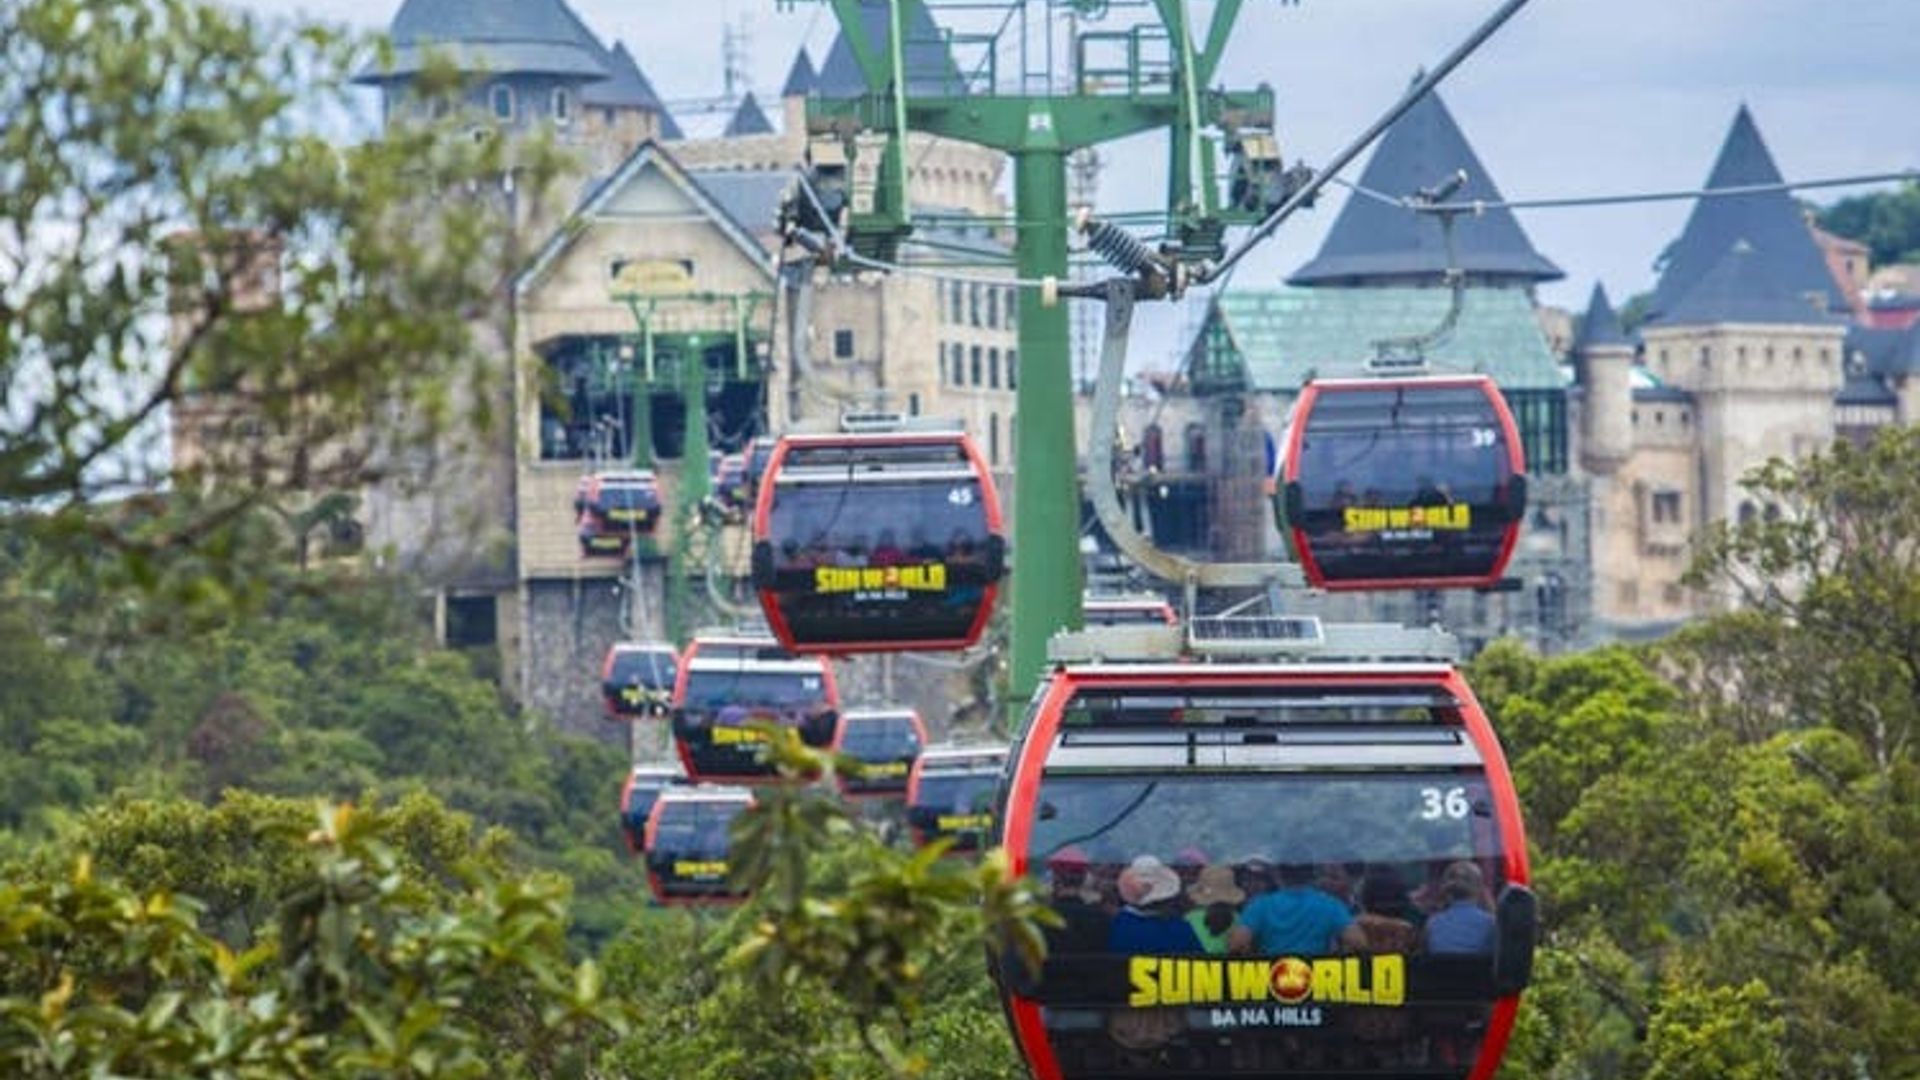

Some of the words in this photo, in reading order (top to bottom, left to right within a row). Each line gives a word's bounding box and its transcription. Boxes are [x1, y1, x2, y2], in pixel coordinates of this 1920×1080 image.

[948, 487, 973, 506] 45
[1420, 787, 1469, 819] 36
[1128, 955, 1223, 1008] SUN
[1211, 1009, 1236, 1027] BA
[1241, 1008, 1268, 1026] NA
[1274, 1008, 1322, 1026] HILLS
